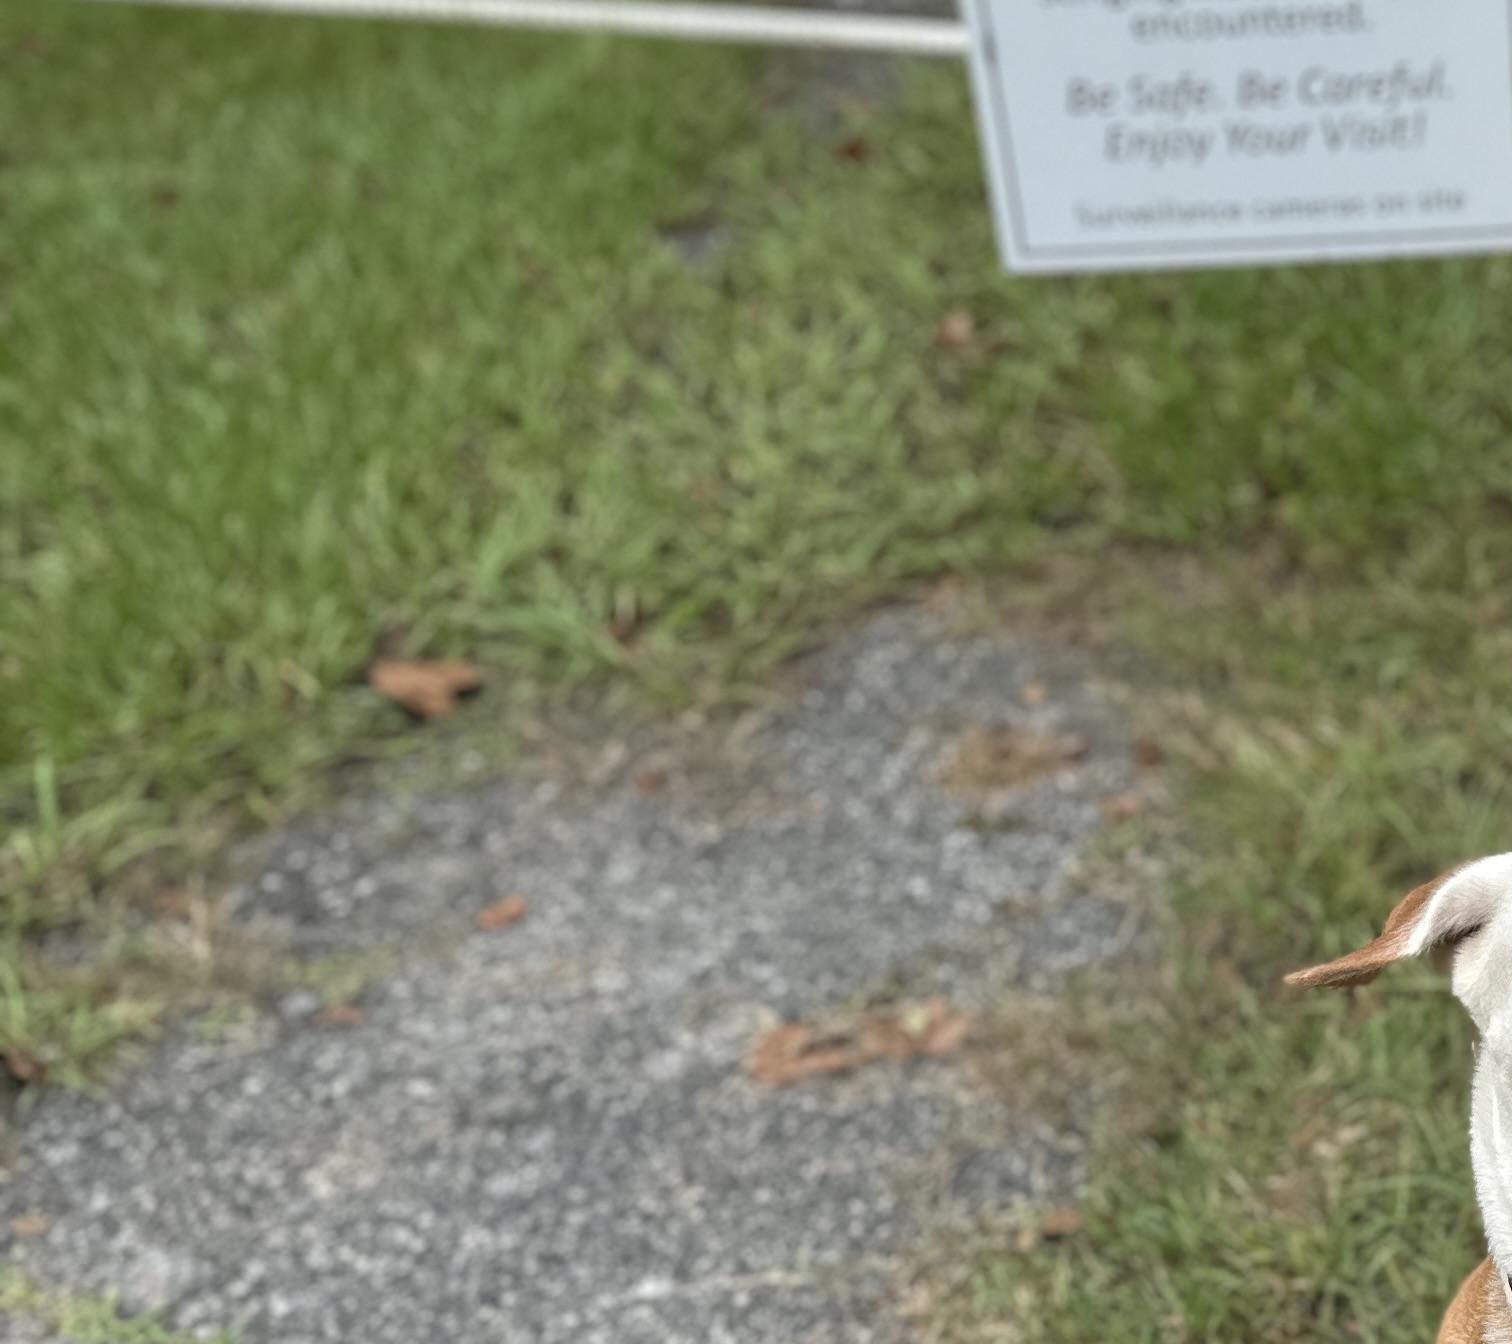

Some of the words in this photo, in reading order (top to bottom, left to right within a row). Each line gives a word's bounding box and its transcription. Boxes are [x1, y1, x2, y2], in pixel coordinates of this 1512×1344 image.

[1131, 0, 1373, 42] encountered.
[1067, 77, 1118, 116] Be
[1238, 69, 1289, 108] Be
[1106, 122, 1215, 165] Enjoy
[1225, 122, 1311, 156] Your
[1323, 110, 1426, 150] Visit!
